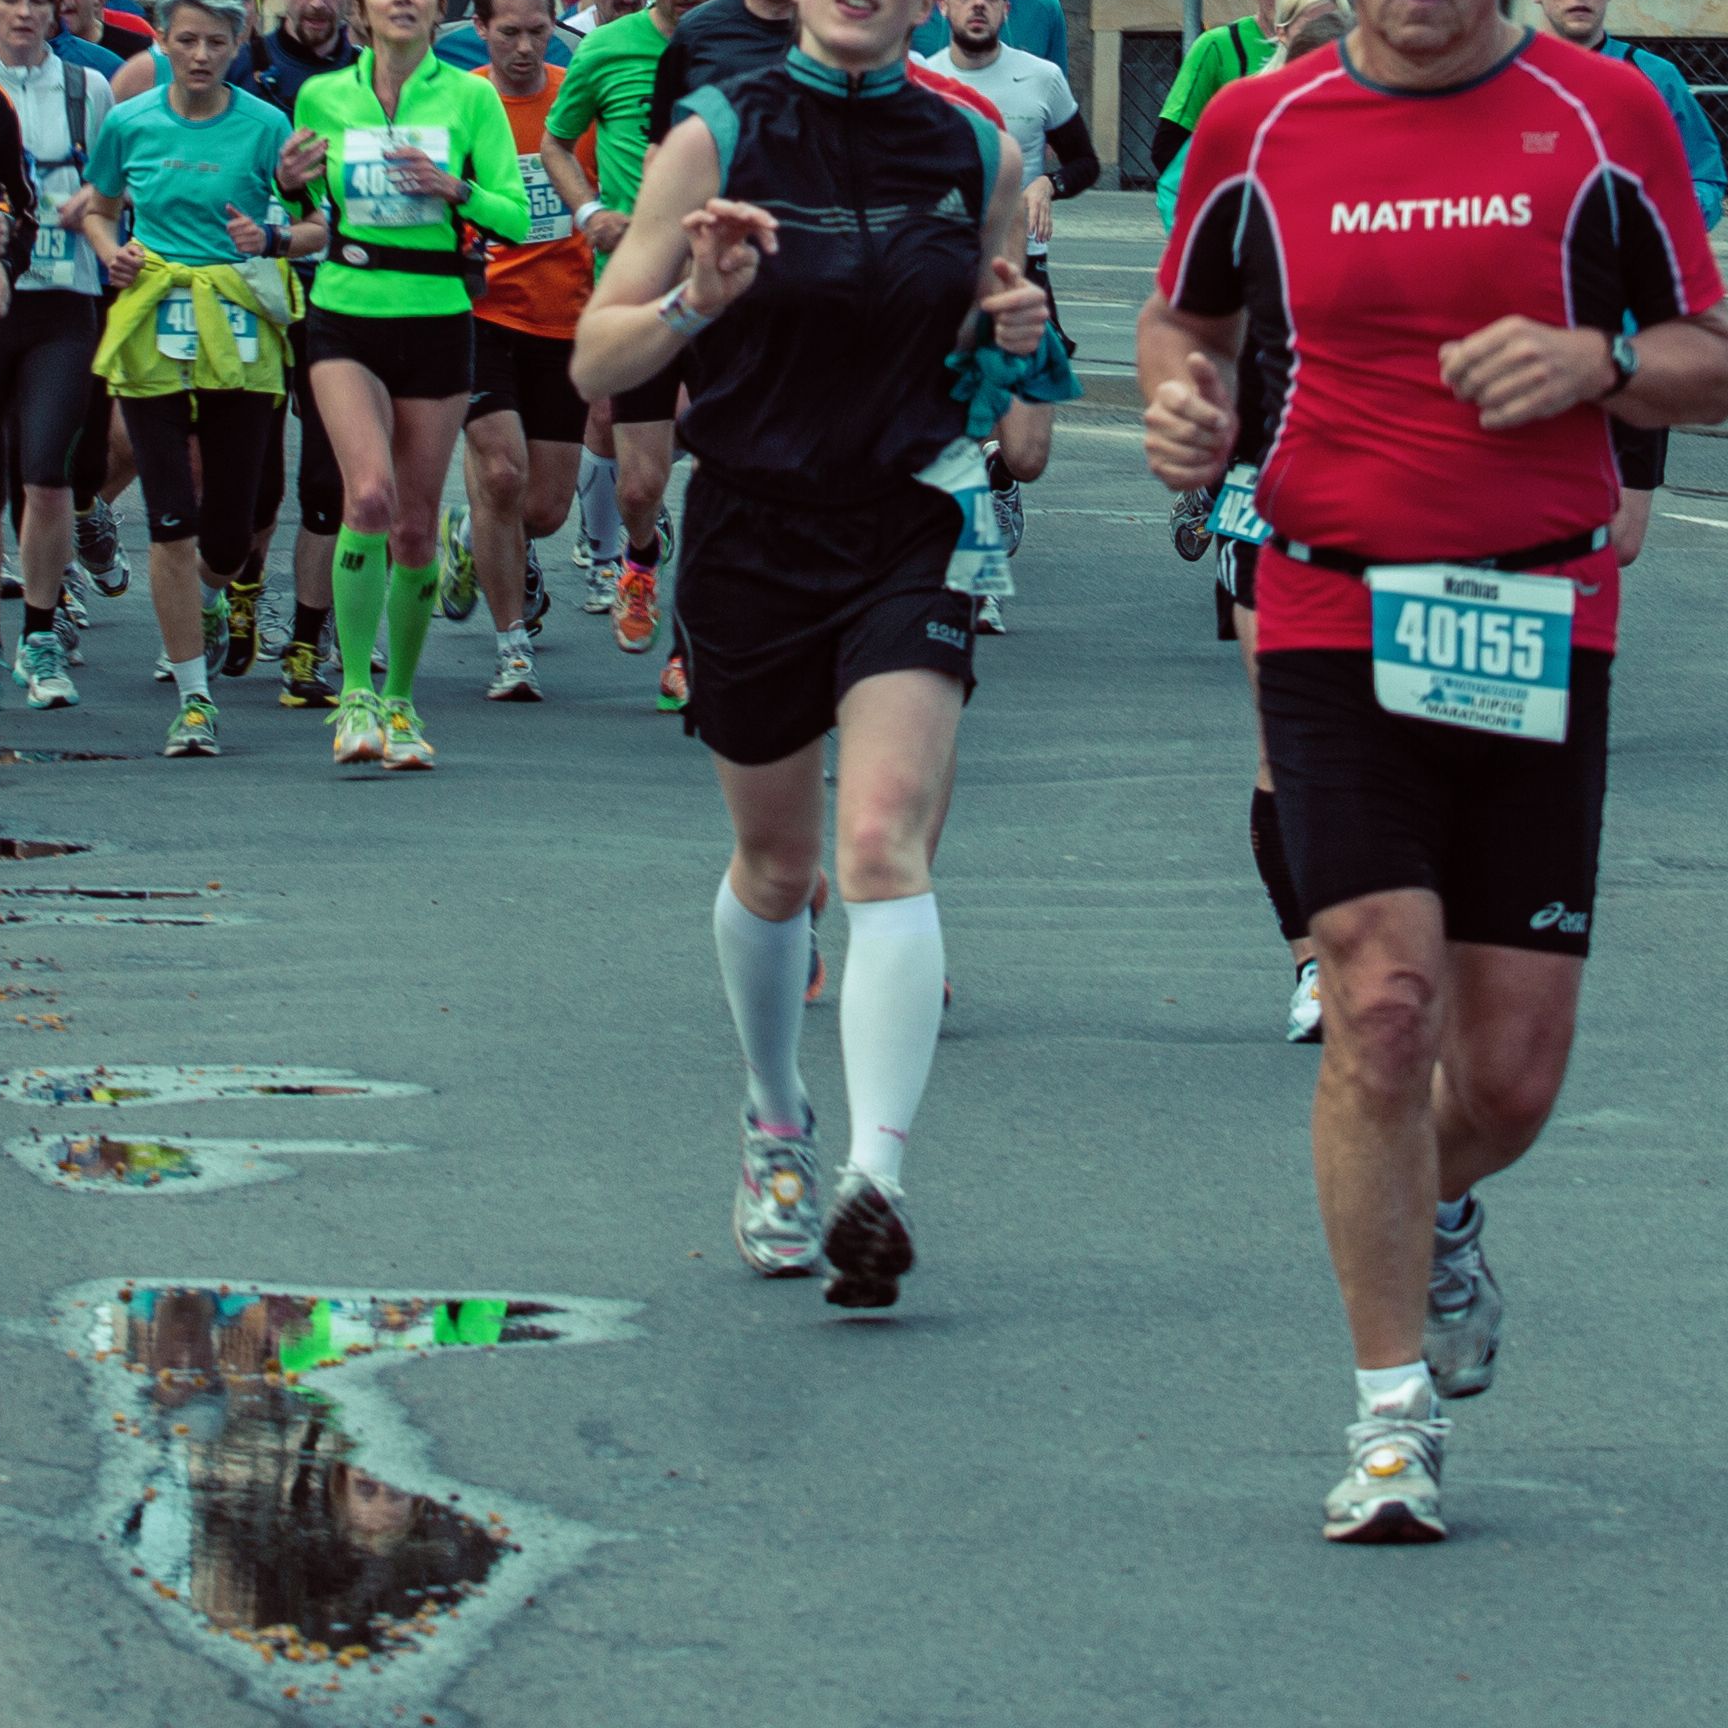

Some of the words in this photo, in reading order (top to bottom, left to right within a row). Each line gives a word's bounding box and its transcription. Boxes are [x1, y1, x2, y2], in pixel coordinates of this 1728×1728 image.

[1330, 193, 1533, 234] MATTHIAS
[1443, 575, 1500, 601] Matthias
[1394, 600, 1545, 681] 40155
[1425, 702, 1507, 727] MARATHON
[1471, 696, 1524, 715] LEIPZIG
